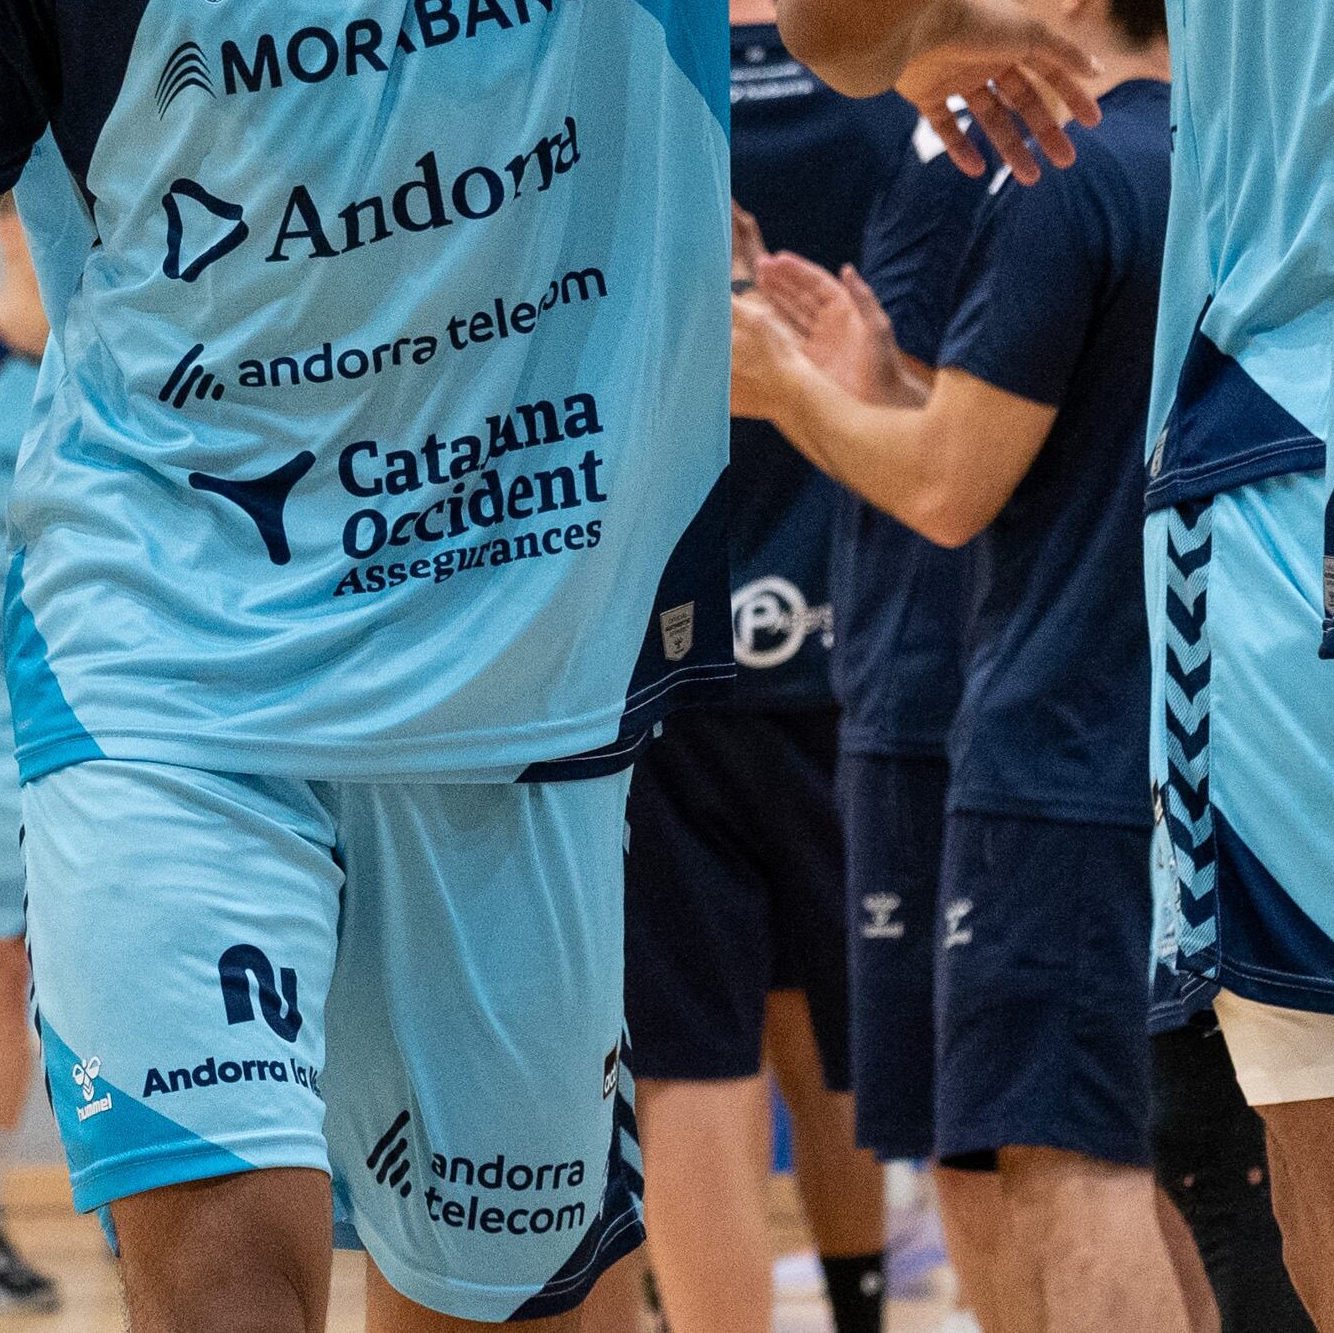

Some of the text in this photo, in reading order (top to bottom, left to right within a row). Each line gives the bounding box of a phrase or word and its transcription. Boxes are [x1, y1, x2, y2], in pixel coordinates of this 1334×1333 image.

[238, 335, 438, 388] andorra
[342, 449, 608, 560] Occident
[142, 1057, 289, 1098] Andorra
[289, 1058, 309, 1089] la
[431, 1154, 586, 1192] andorra
[424, 1185, 586, 1236] telecom
